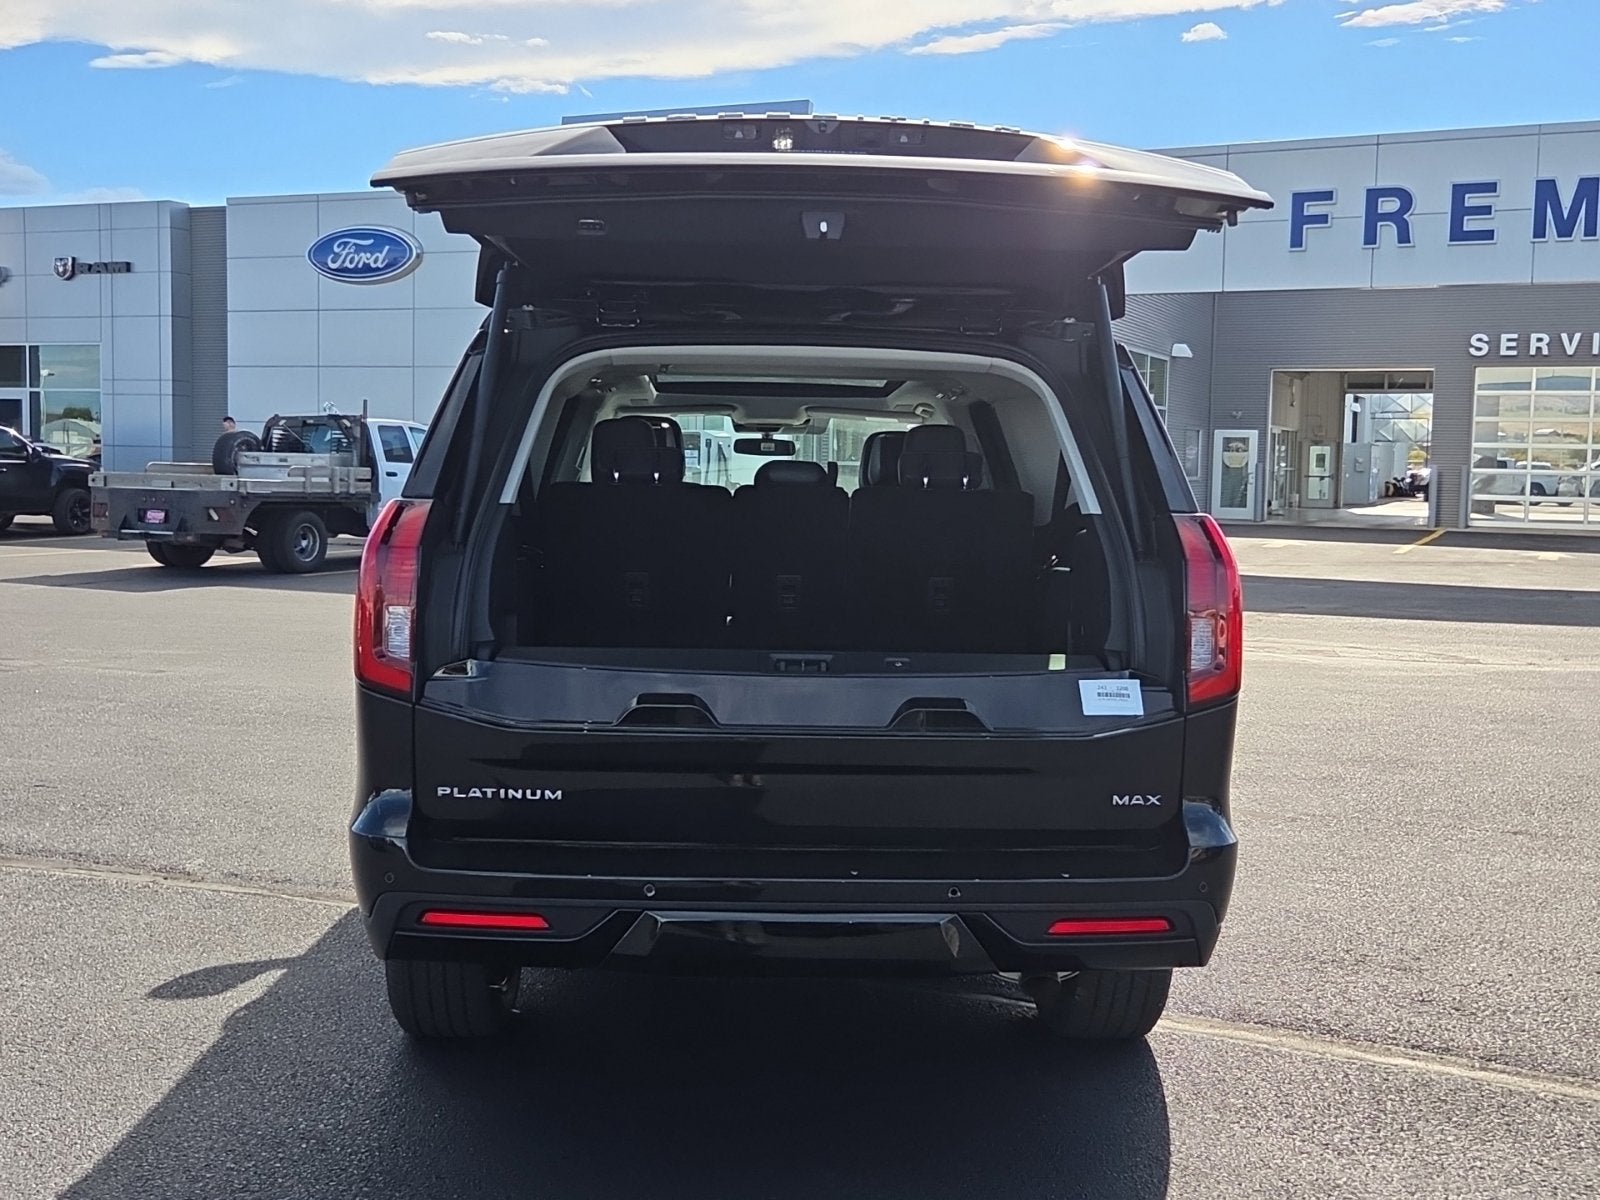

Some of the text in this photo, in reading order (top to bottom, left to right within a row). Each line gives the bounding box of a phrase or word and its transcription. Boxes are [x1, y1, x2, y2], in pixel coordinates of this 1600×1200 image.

[1290, 177, 1600, 251] FREM
[328, 238, 389, 269] Ford
[76, 261, 131, 274] RAM
[1469, 332, 1600, 357] SERVI
[437, 786, 562, 800] PLATINUM
[1112, 795, 1161, 805] MAX
